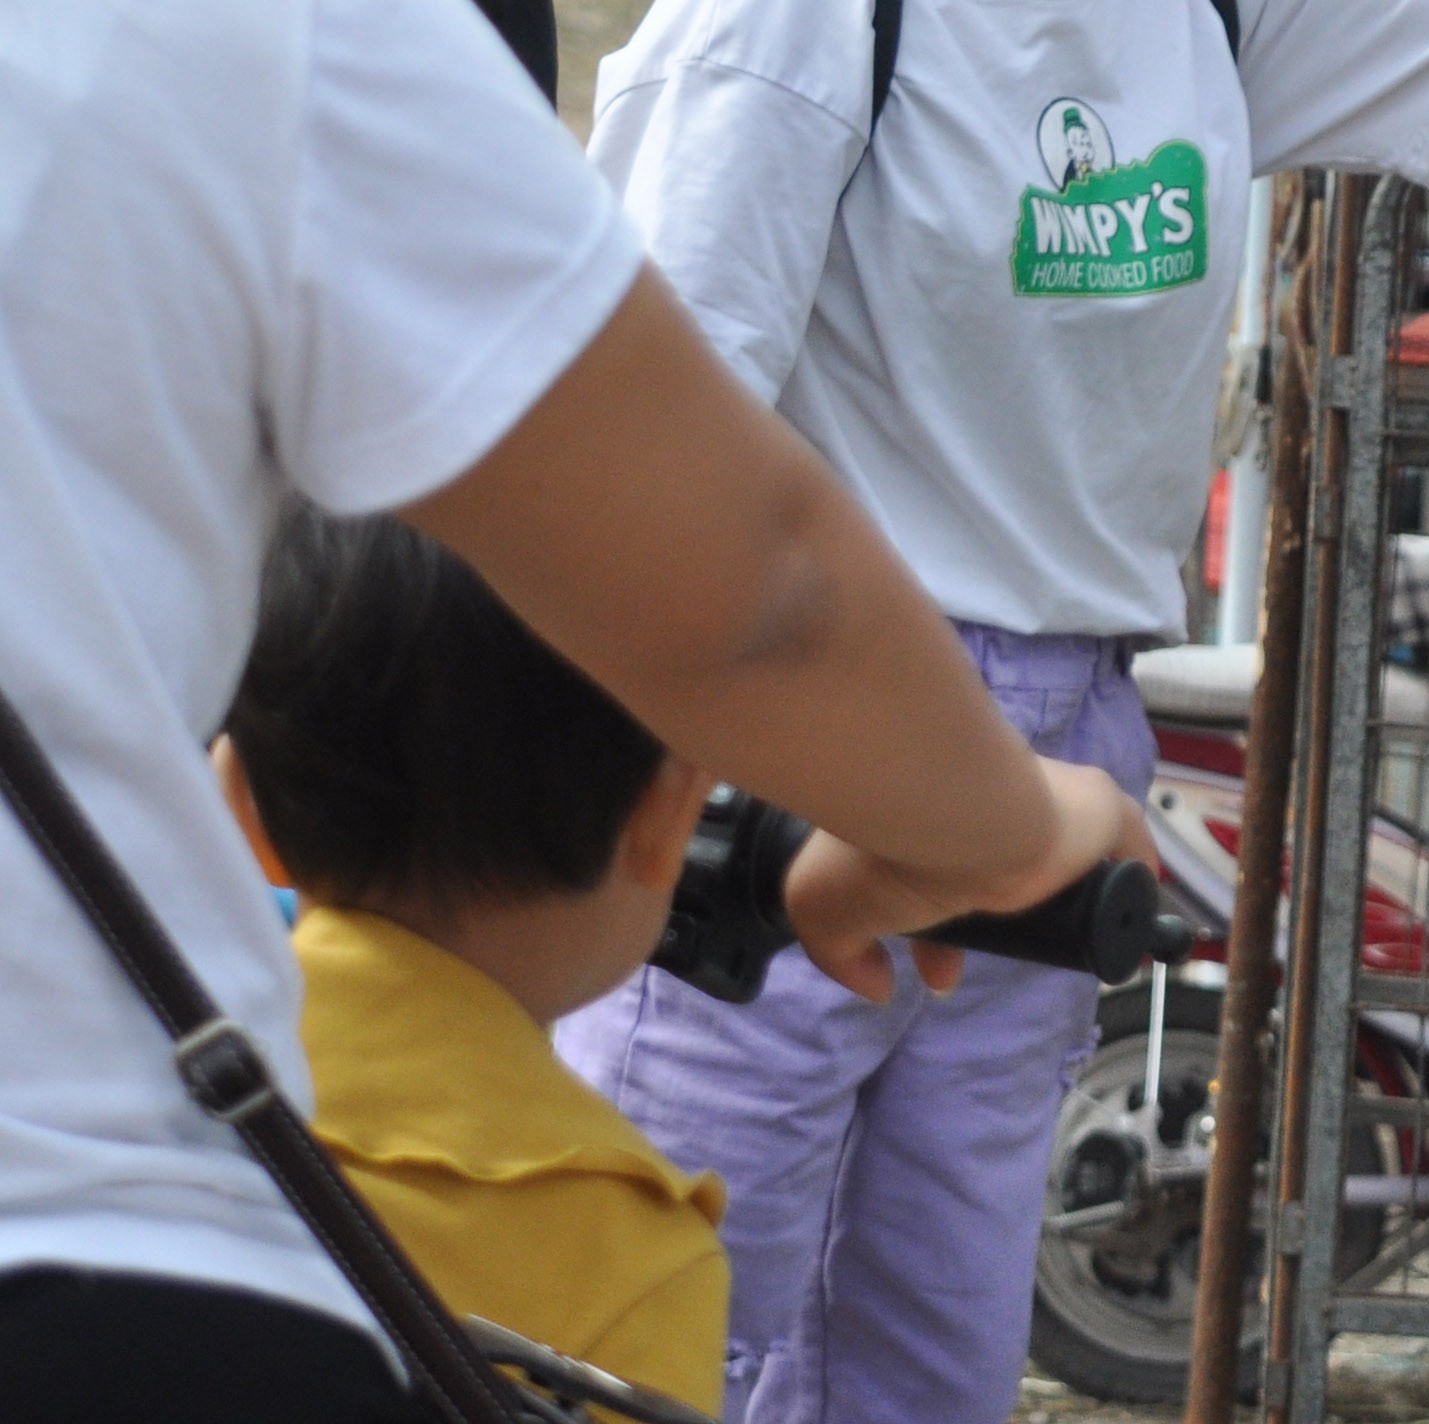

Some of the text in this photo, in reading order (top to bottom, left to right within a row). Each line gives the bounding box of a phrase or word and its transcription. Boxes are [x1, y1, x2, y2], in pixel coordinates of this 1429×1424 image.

[1030, 250, 1194, 289] HOME COOKED FOOD
